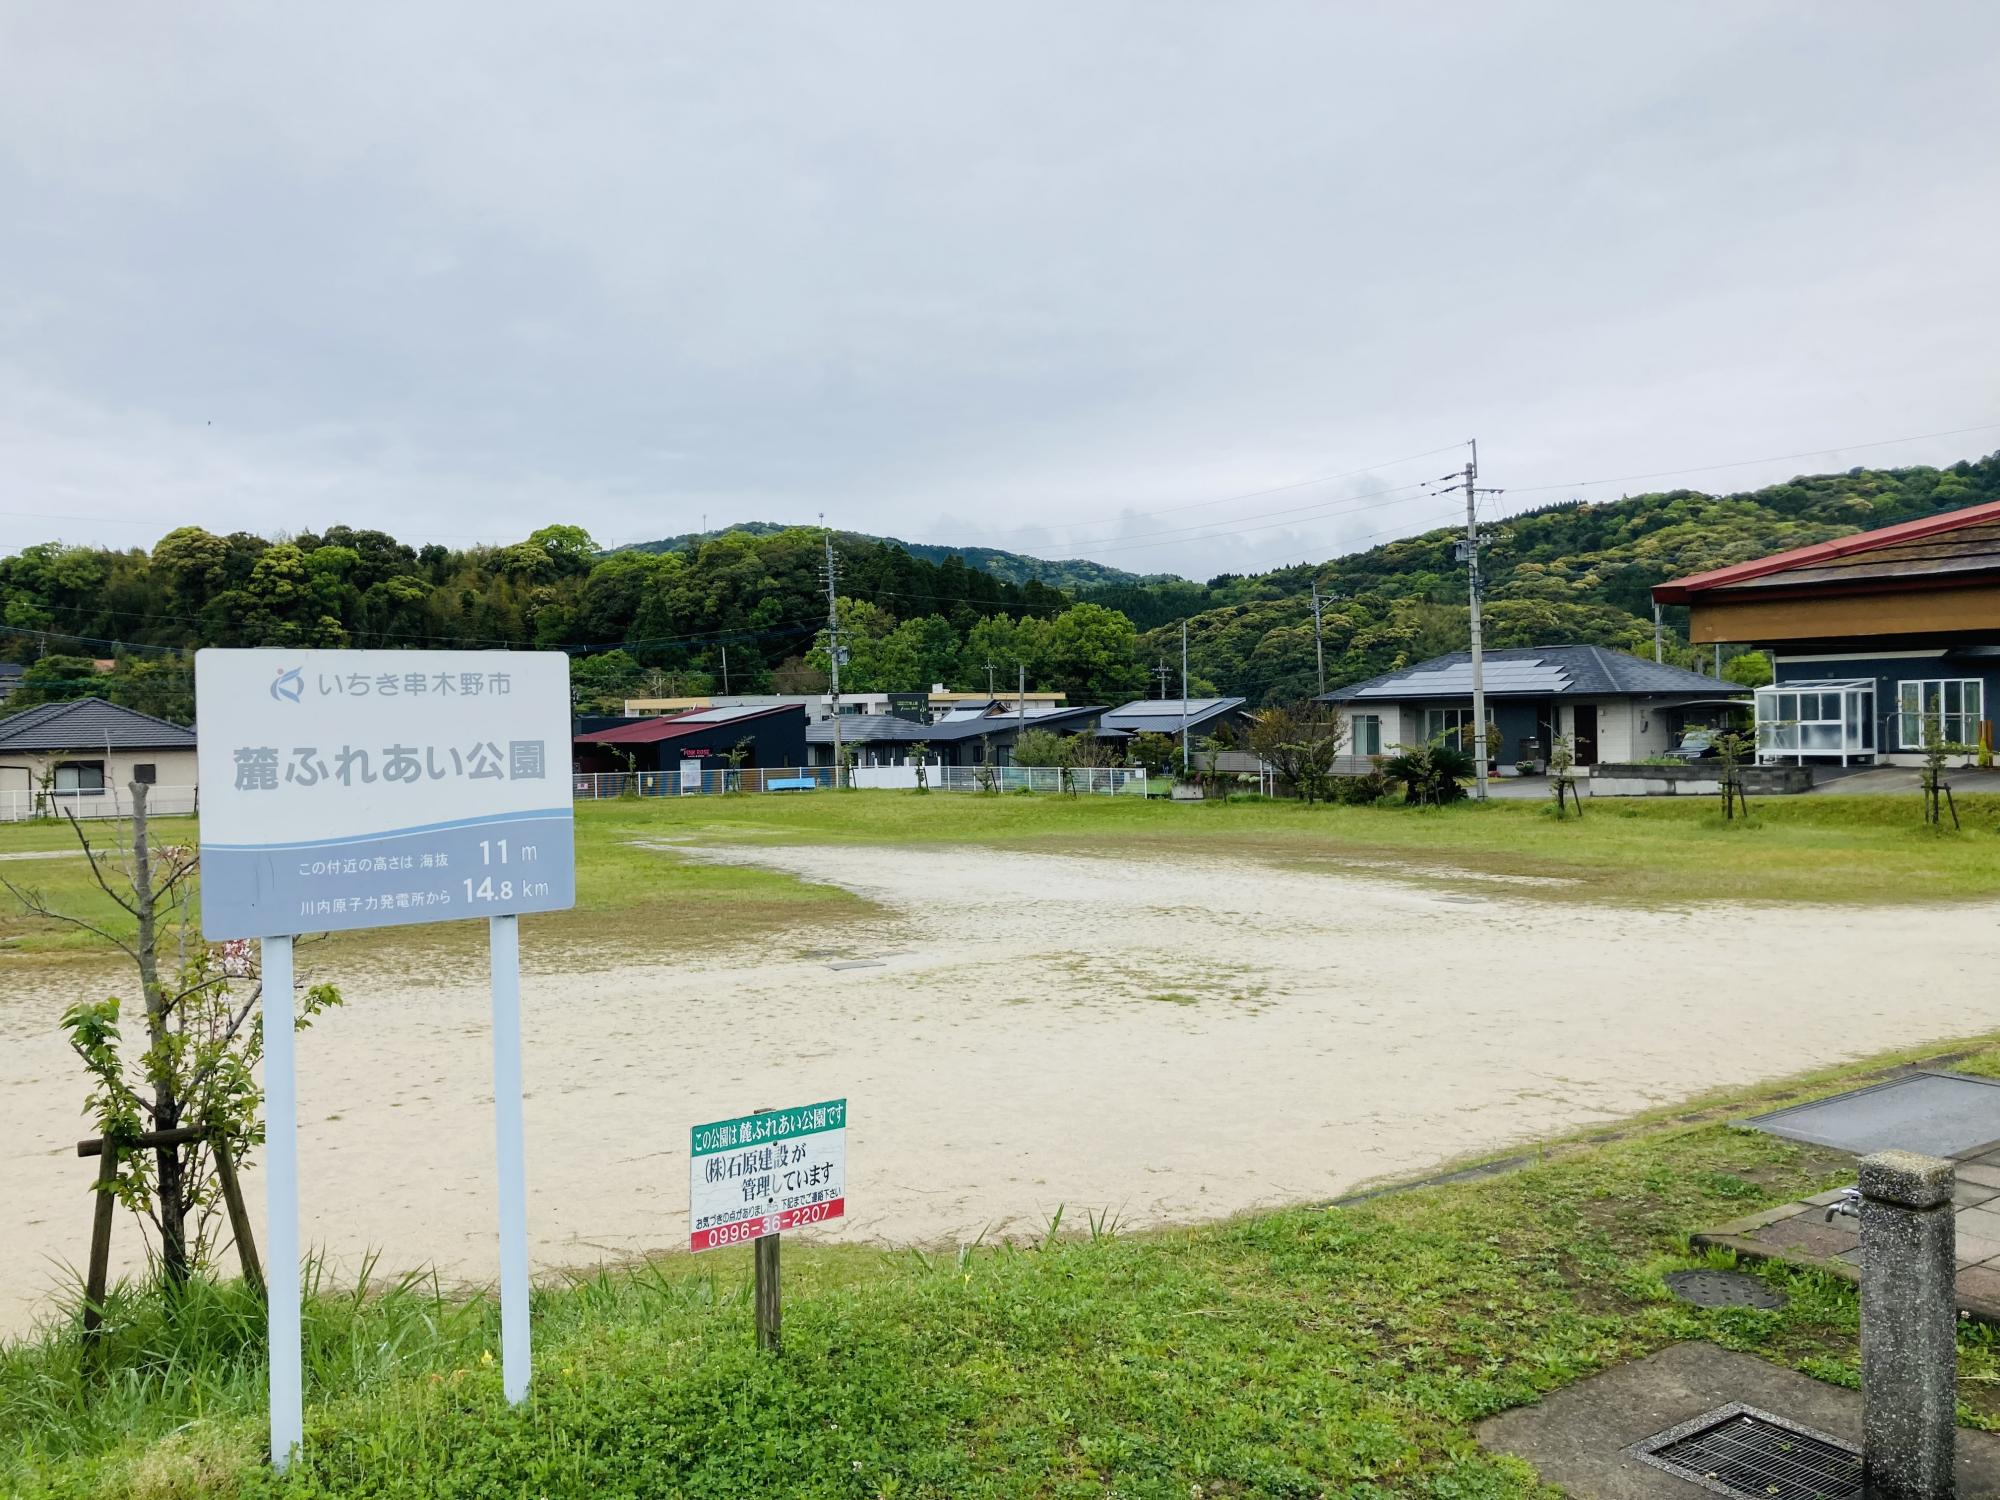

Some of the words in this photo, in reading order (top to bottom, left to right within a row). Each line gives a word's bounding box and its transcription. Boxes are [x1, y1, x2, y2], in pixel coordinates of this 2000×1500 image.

[318, 671, 511, 698] いちき串木野市
[232, 740, 546, 791] 麓ふれあい公園
[299, 855, 413, 876] この付近の高さは
[420, 853, 449, 869] 海抜
[479, 839, 508, 865] 11
[522, 845, 538, 861] m
[300, 889, 451, 916] 川内原子力発電所から
[463, 876, 513, 904] 14.8
[522, 880, 549, 898] km
[742, 1162, 834, 1202] 管理しています
[708, 1203, 831, 1247] 0996-36-2207
